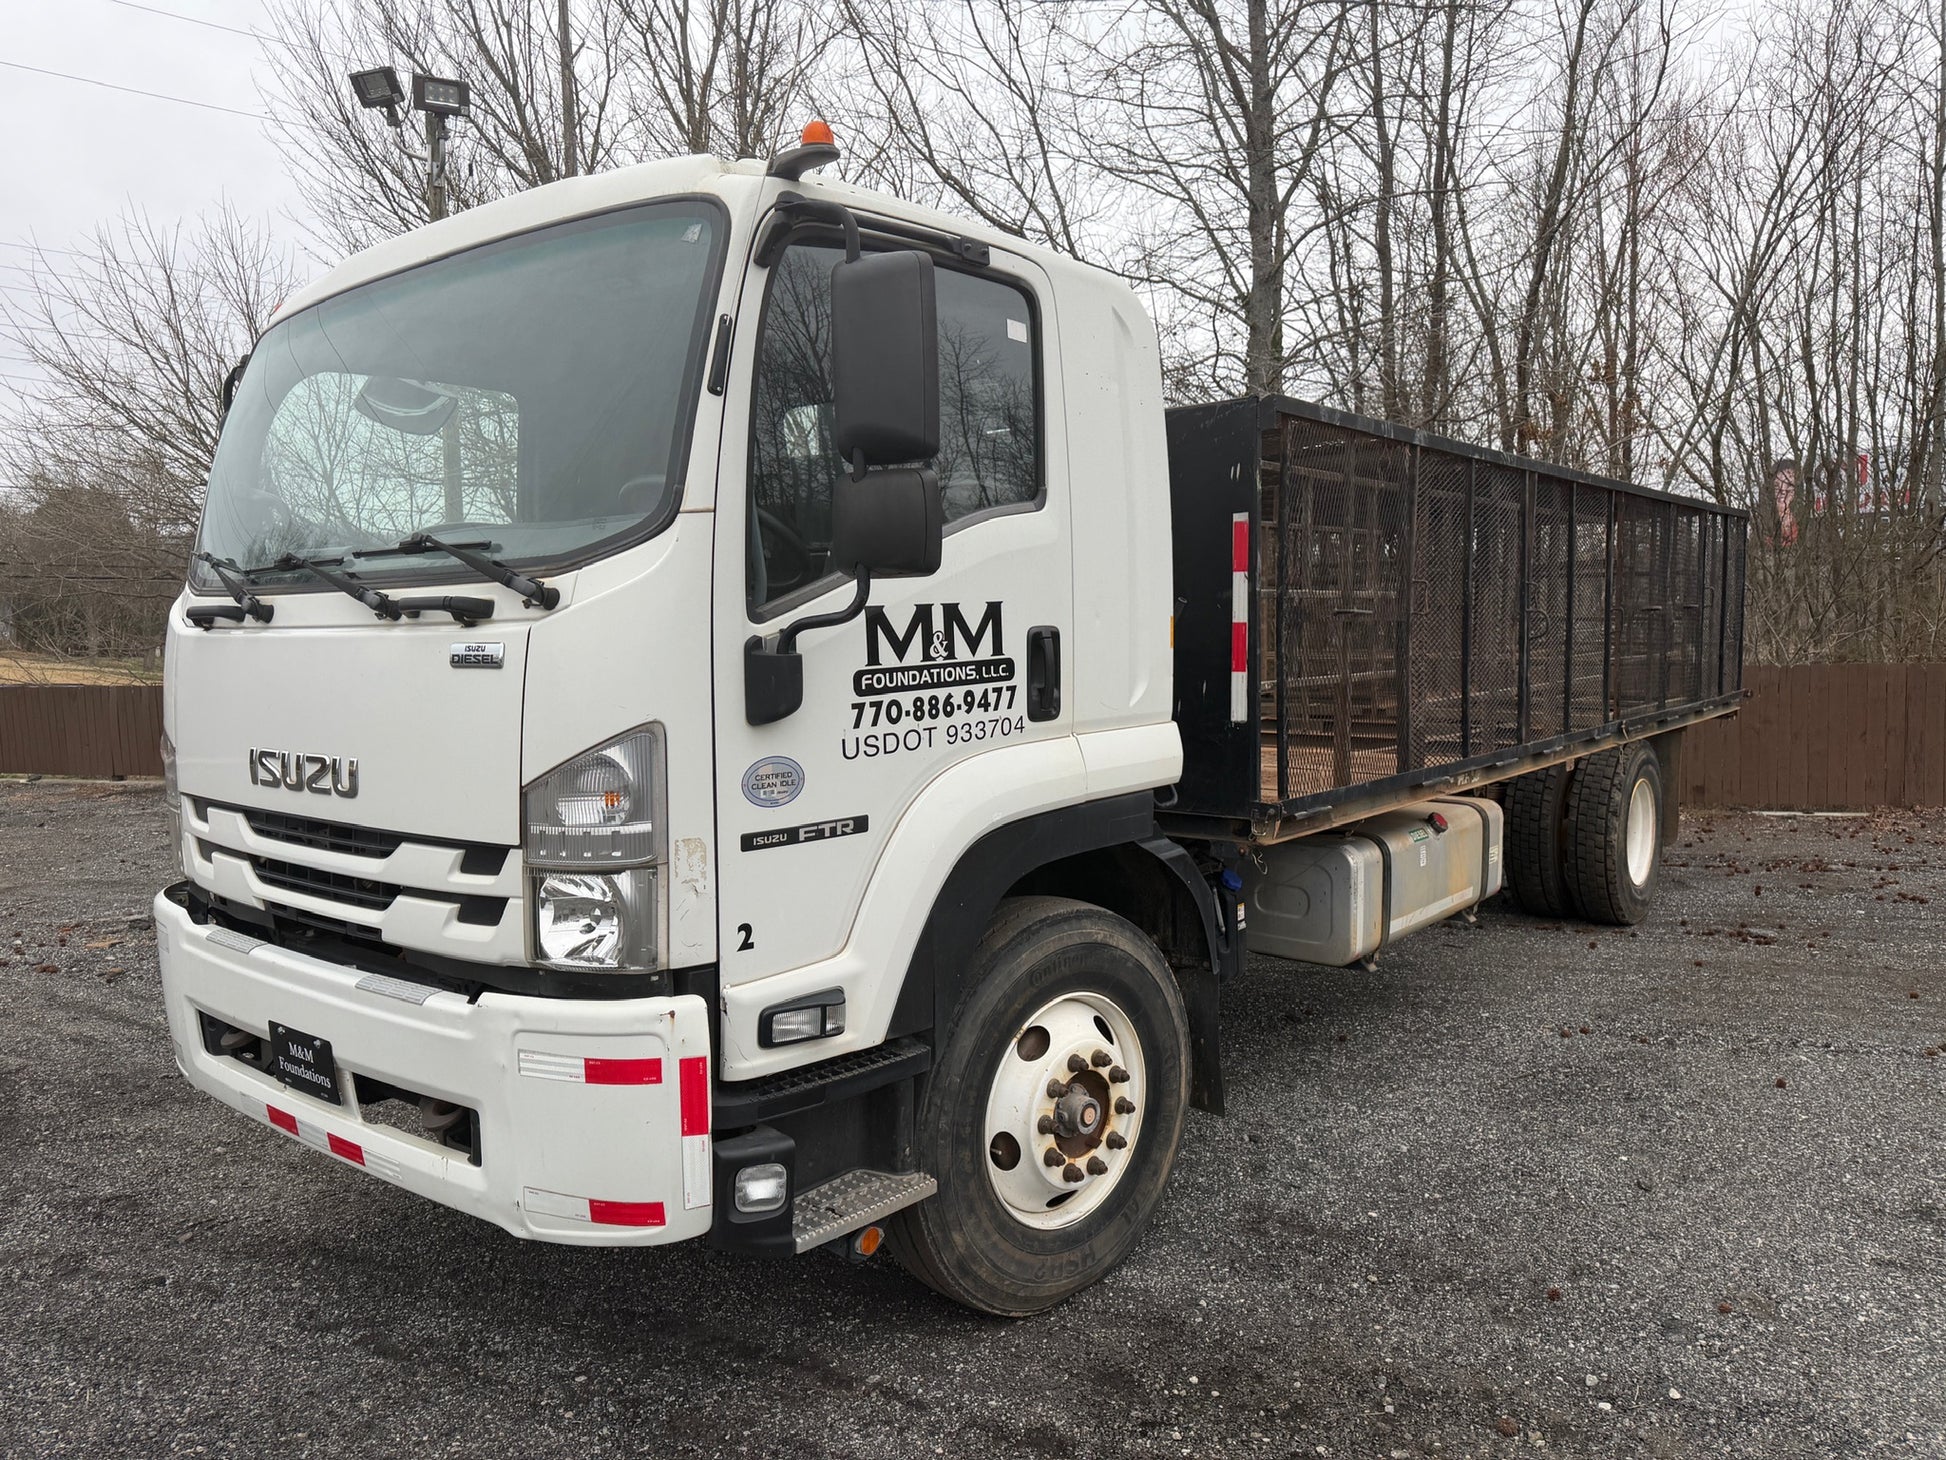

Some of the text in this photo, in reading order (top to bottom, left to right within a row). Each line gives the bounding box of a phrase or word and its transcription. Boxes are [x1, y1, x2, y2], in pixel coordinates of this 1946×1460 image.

[864, 601, 1005, 666] M&M
[451, 654, 499, 664] DIESEL
[851, 685, 1017, 730] 770-886-9477
[841, 715, 1026, 760] USDOT 933704
[249, 746, 360, 799] ISUZU
[751, 778, 797, 791] CLEAN IDLE
[754, 771, 793, 782] CERTIFIED
[753, 819, 855, 846] ISUZU FTR
[736, 922, 755, 953] 2
[288, 1041, 314, 1063] M&M
[278, 1055, 332, 1089] Foundations
